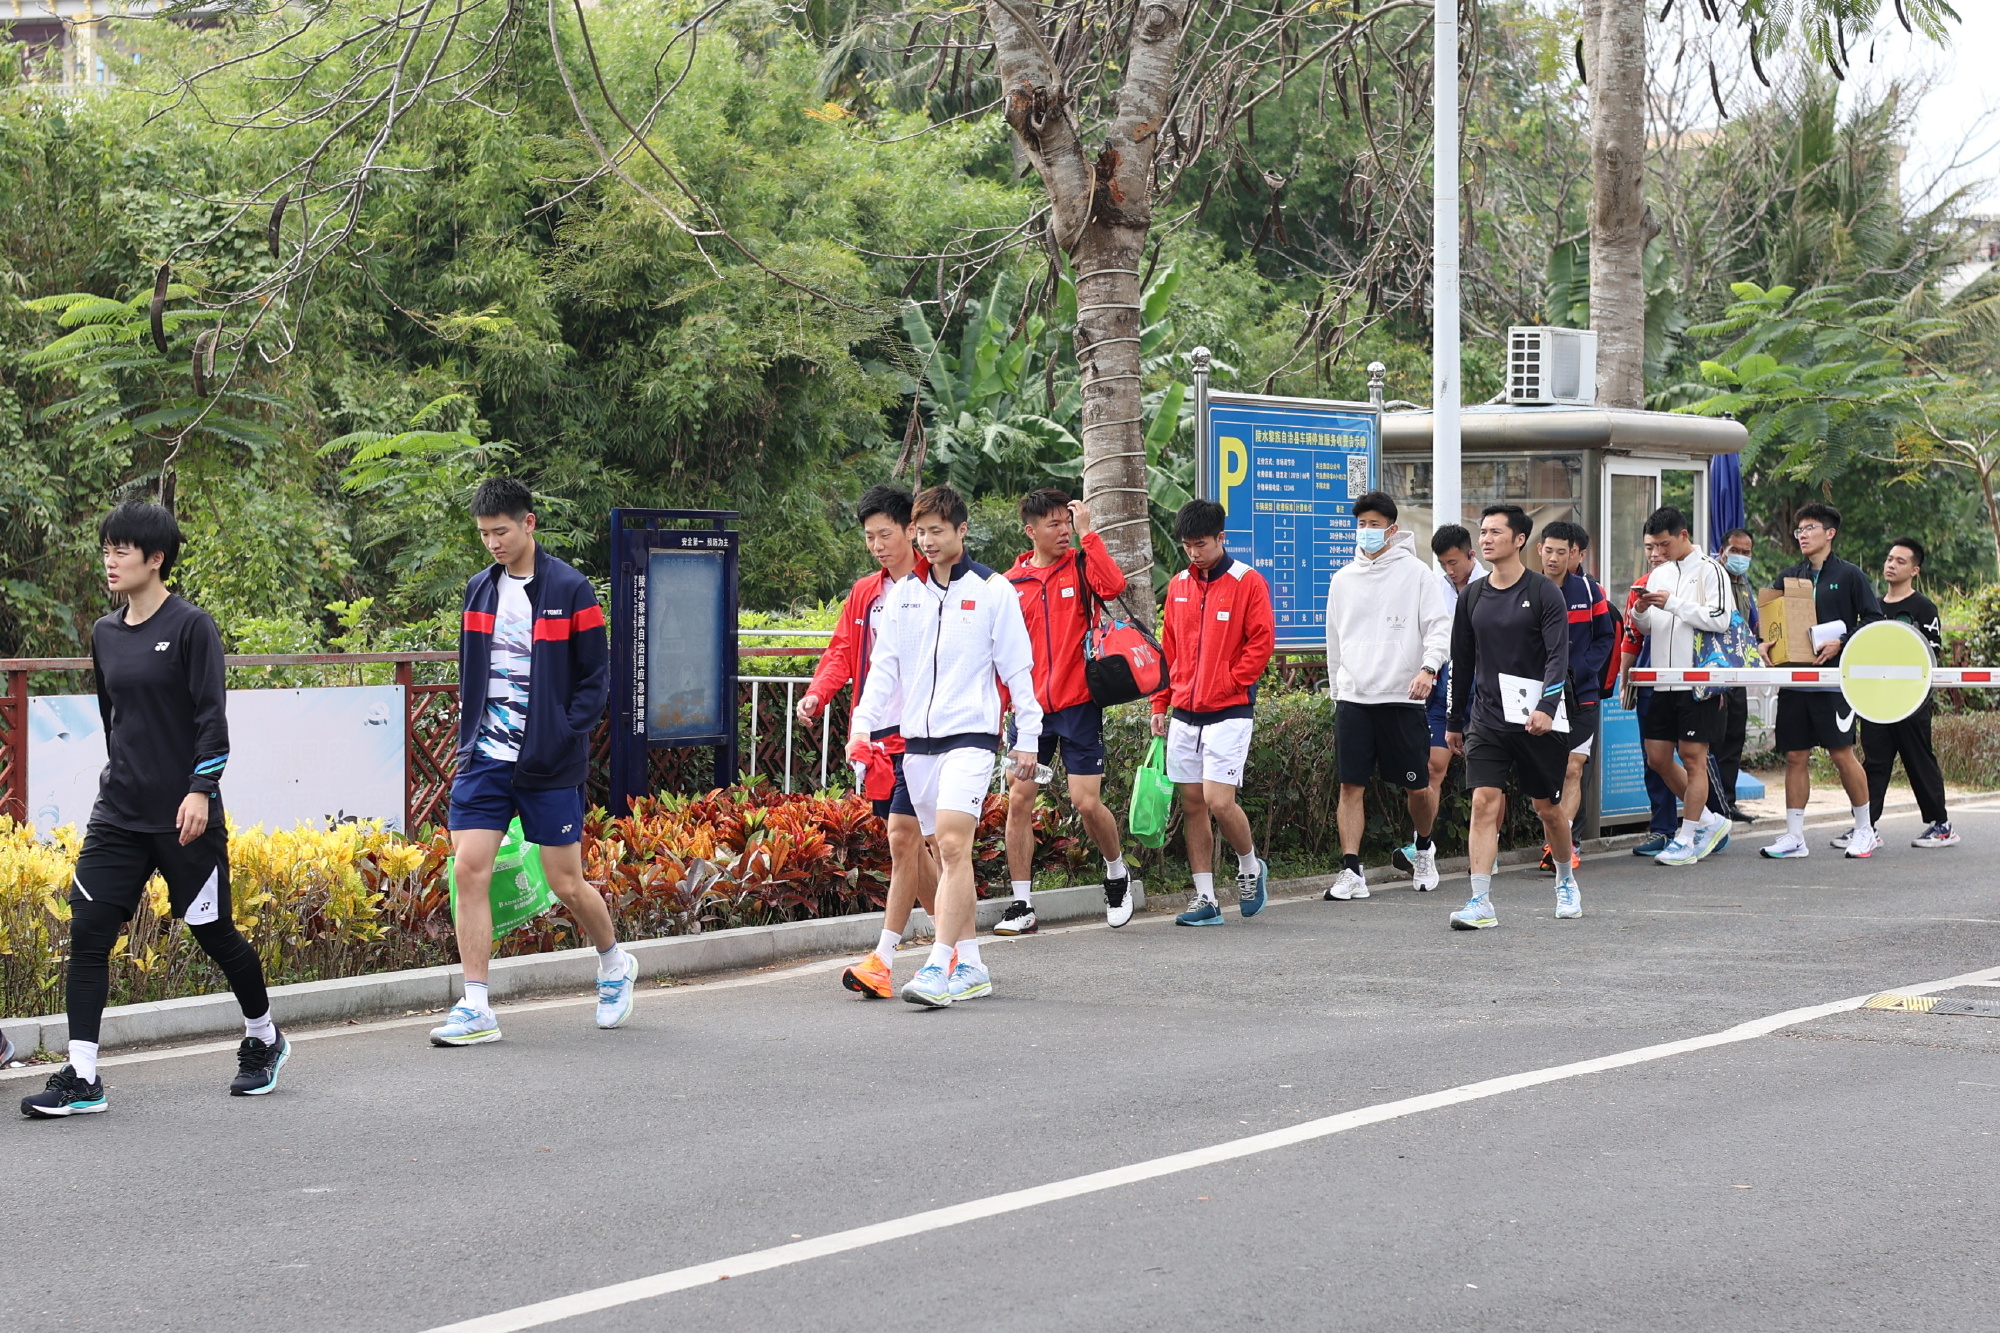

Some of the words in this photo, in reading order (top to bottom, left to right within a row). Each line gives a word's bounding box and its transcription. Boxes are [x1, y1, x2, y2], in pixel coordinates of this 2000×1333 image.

[1255, 429, 1367, 449] 陵水黎族自治县车辆停放服务收费告示牌
[1219, 436, 1248, 517] P
[681, 537, 704, 547] 安全第一
[706, 537, 729, 547] 预防为主
[1301, 558, 1307, 568] 元
[637, 574, 646, 734] 陵水黎族自治县应急管理局
